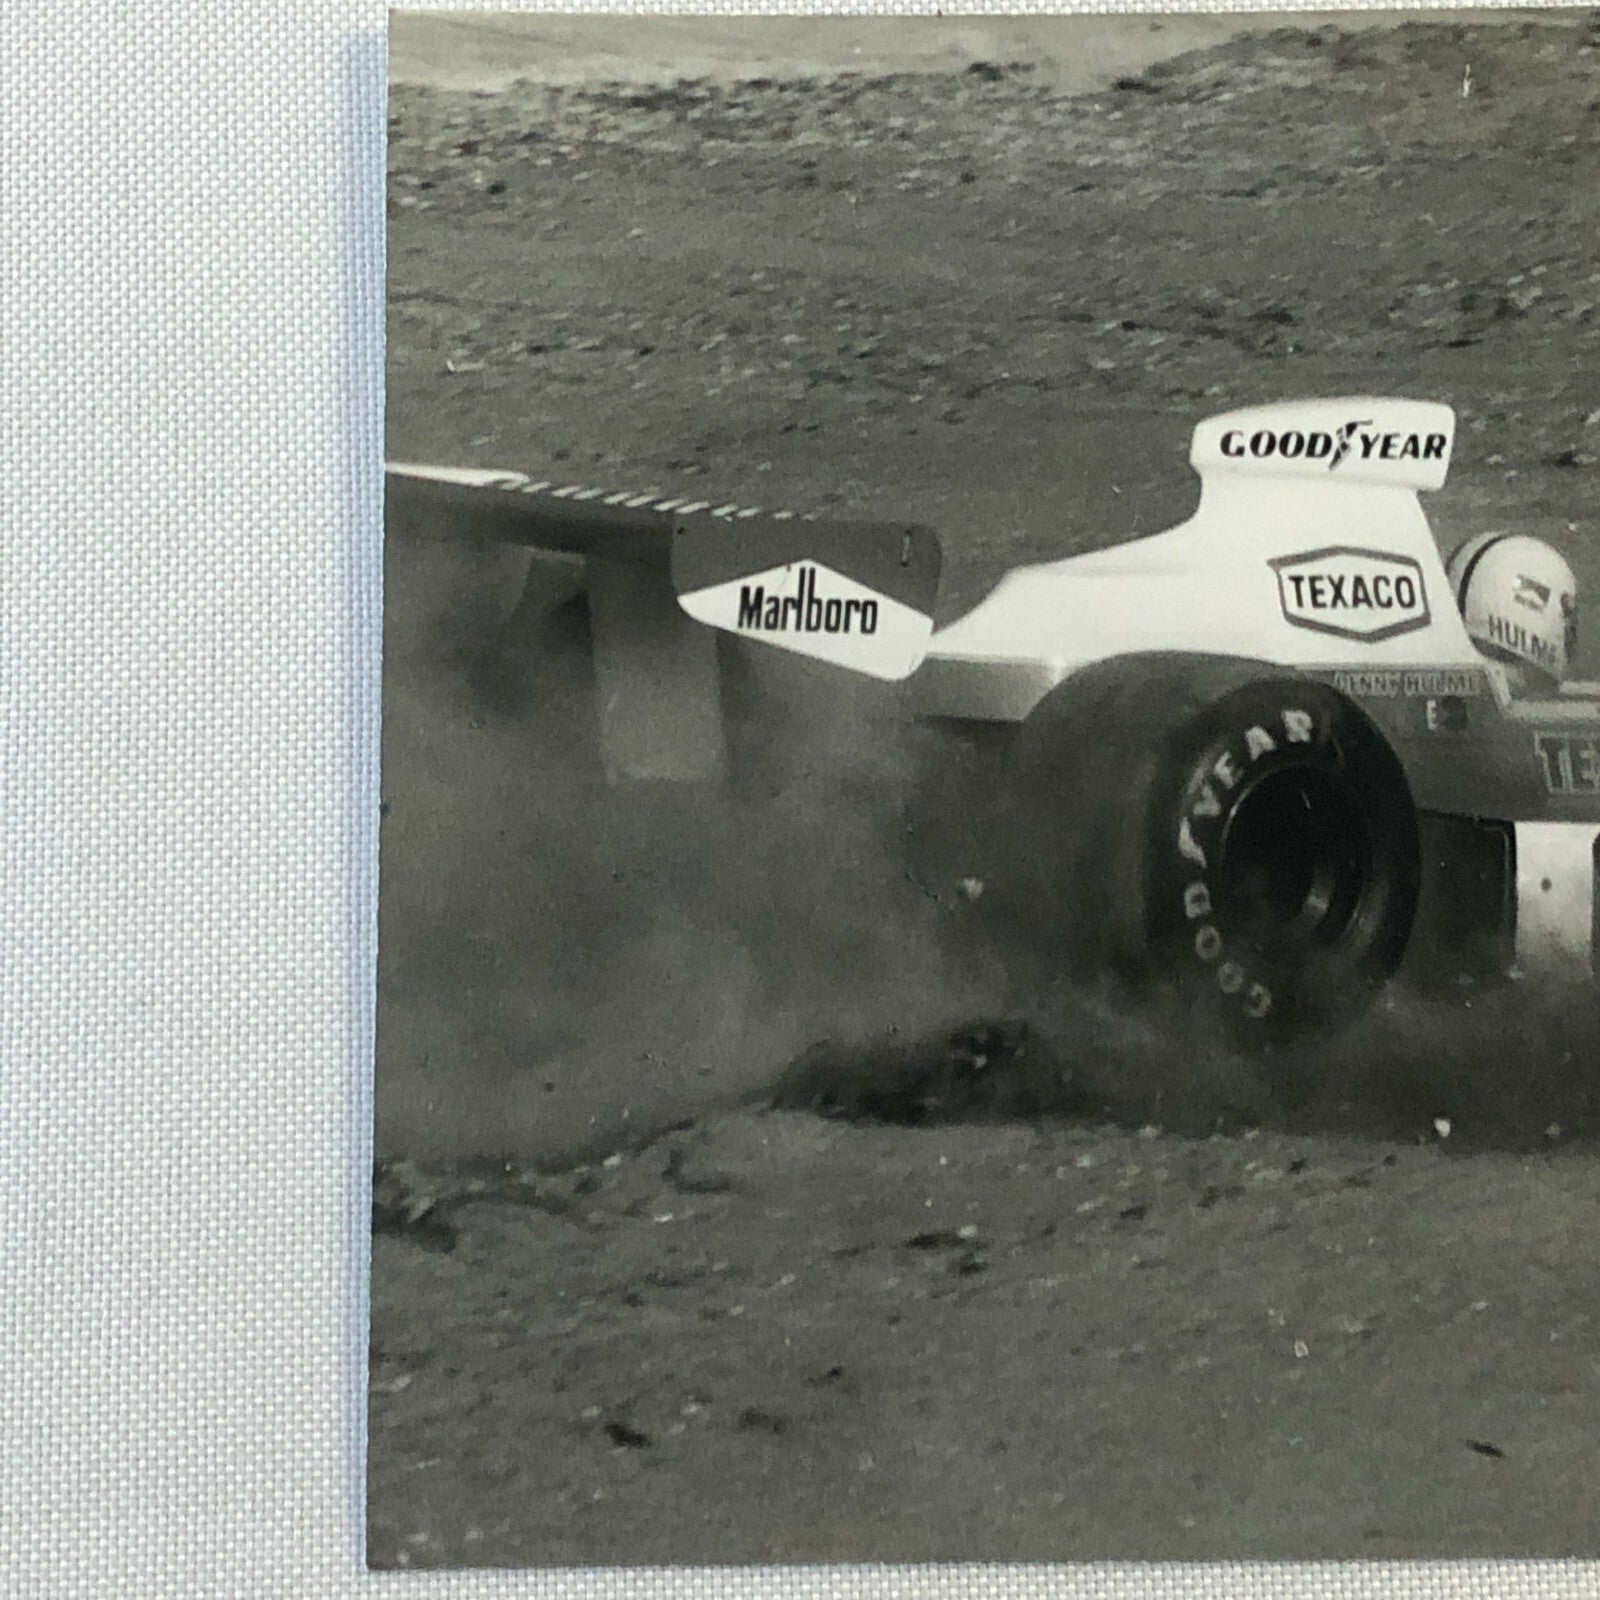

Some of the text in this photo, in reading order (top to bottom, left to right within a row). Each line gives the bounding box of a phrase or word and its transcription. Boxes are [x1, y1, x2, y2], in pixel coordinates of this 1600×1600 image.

[1220, 427, 1447, 462] GOODYEAR
[738, 567, 878, 634] Marlboro
[1288, 574, 1416, 609] TEXACO
[1533, 731, 1600, 794] TE
